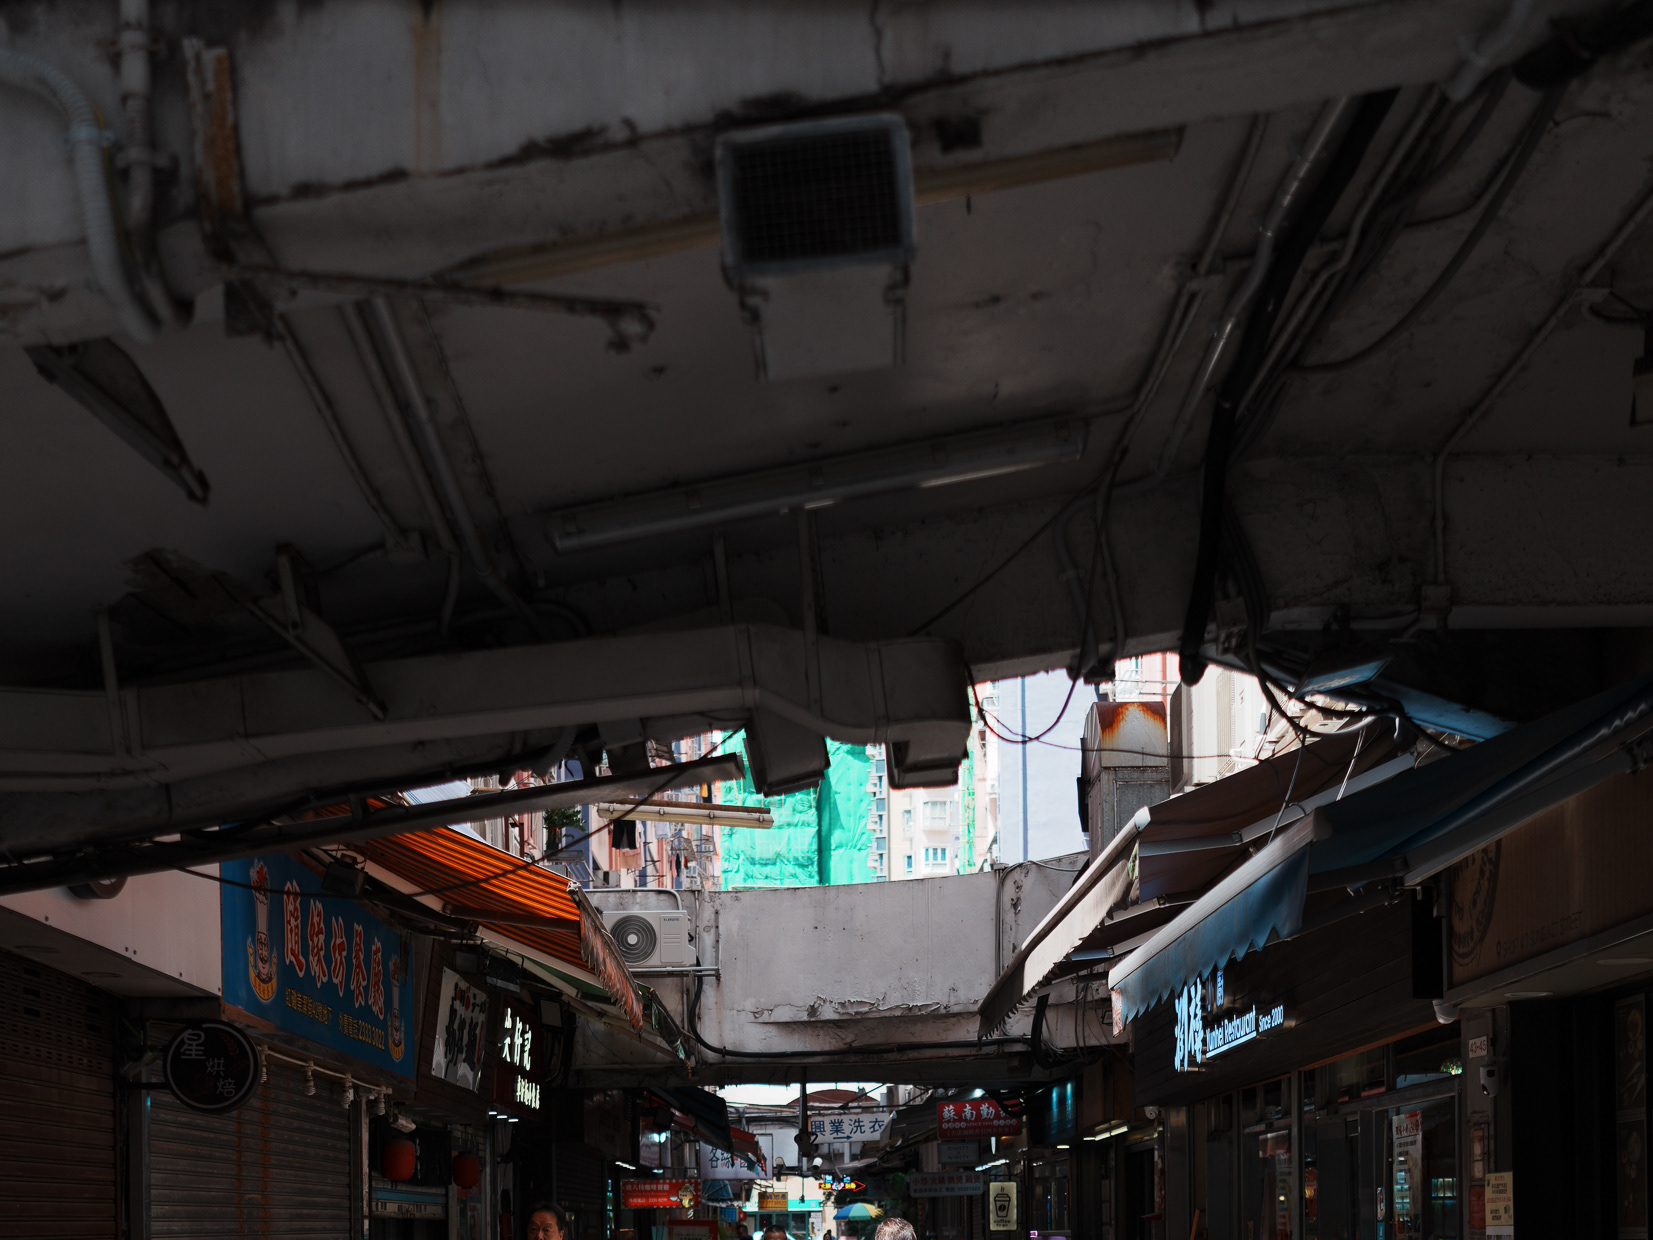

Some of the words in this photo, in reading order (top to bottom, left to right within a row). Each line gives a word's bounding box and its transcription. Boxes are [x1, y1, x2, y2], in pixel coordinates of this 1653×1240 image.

[283, 879, 385, 1021] 隨緣坊餐廳
[1206, 1021, 1224, 1051] Yunhei
[1224, 1003, 1256, 1044] Restaurant
[1259, 1014, 1271, 1032] Since
[1271, 1005, 1284, 1028] 2000
[1469, 1039, 1487, 1054] 43-45
[810, 1118, 885, 1136] 興業洗衣
